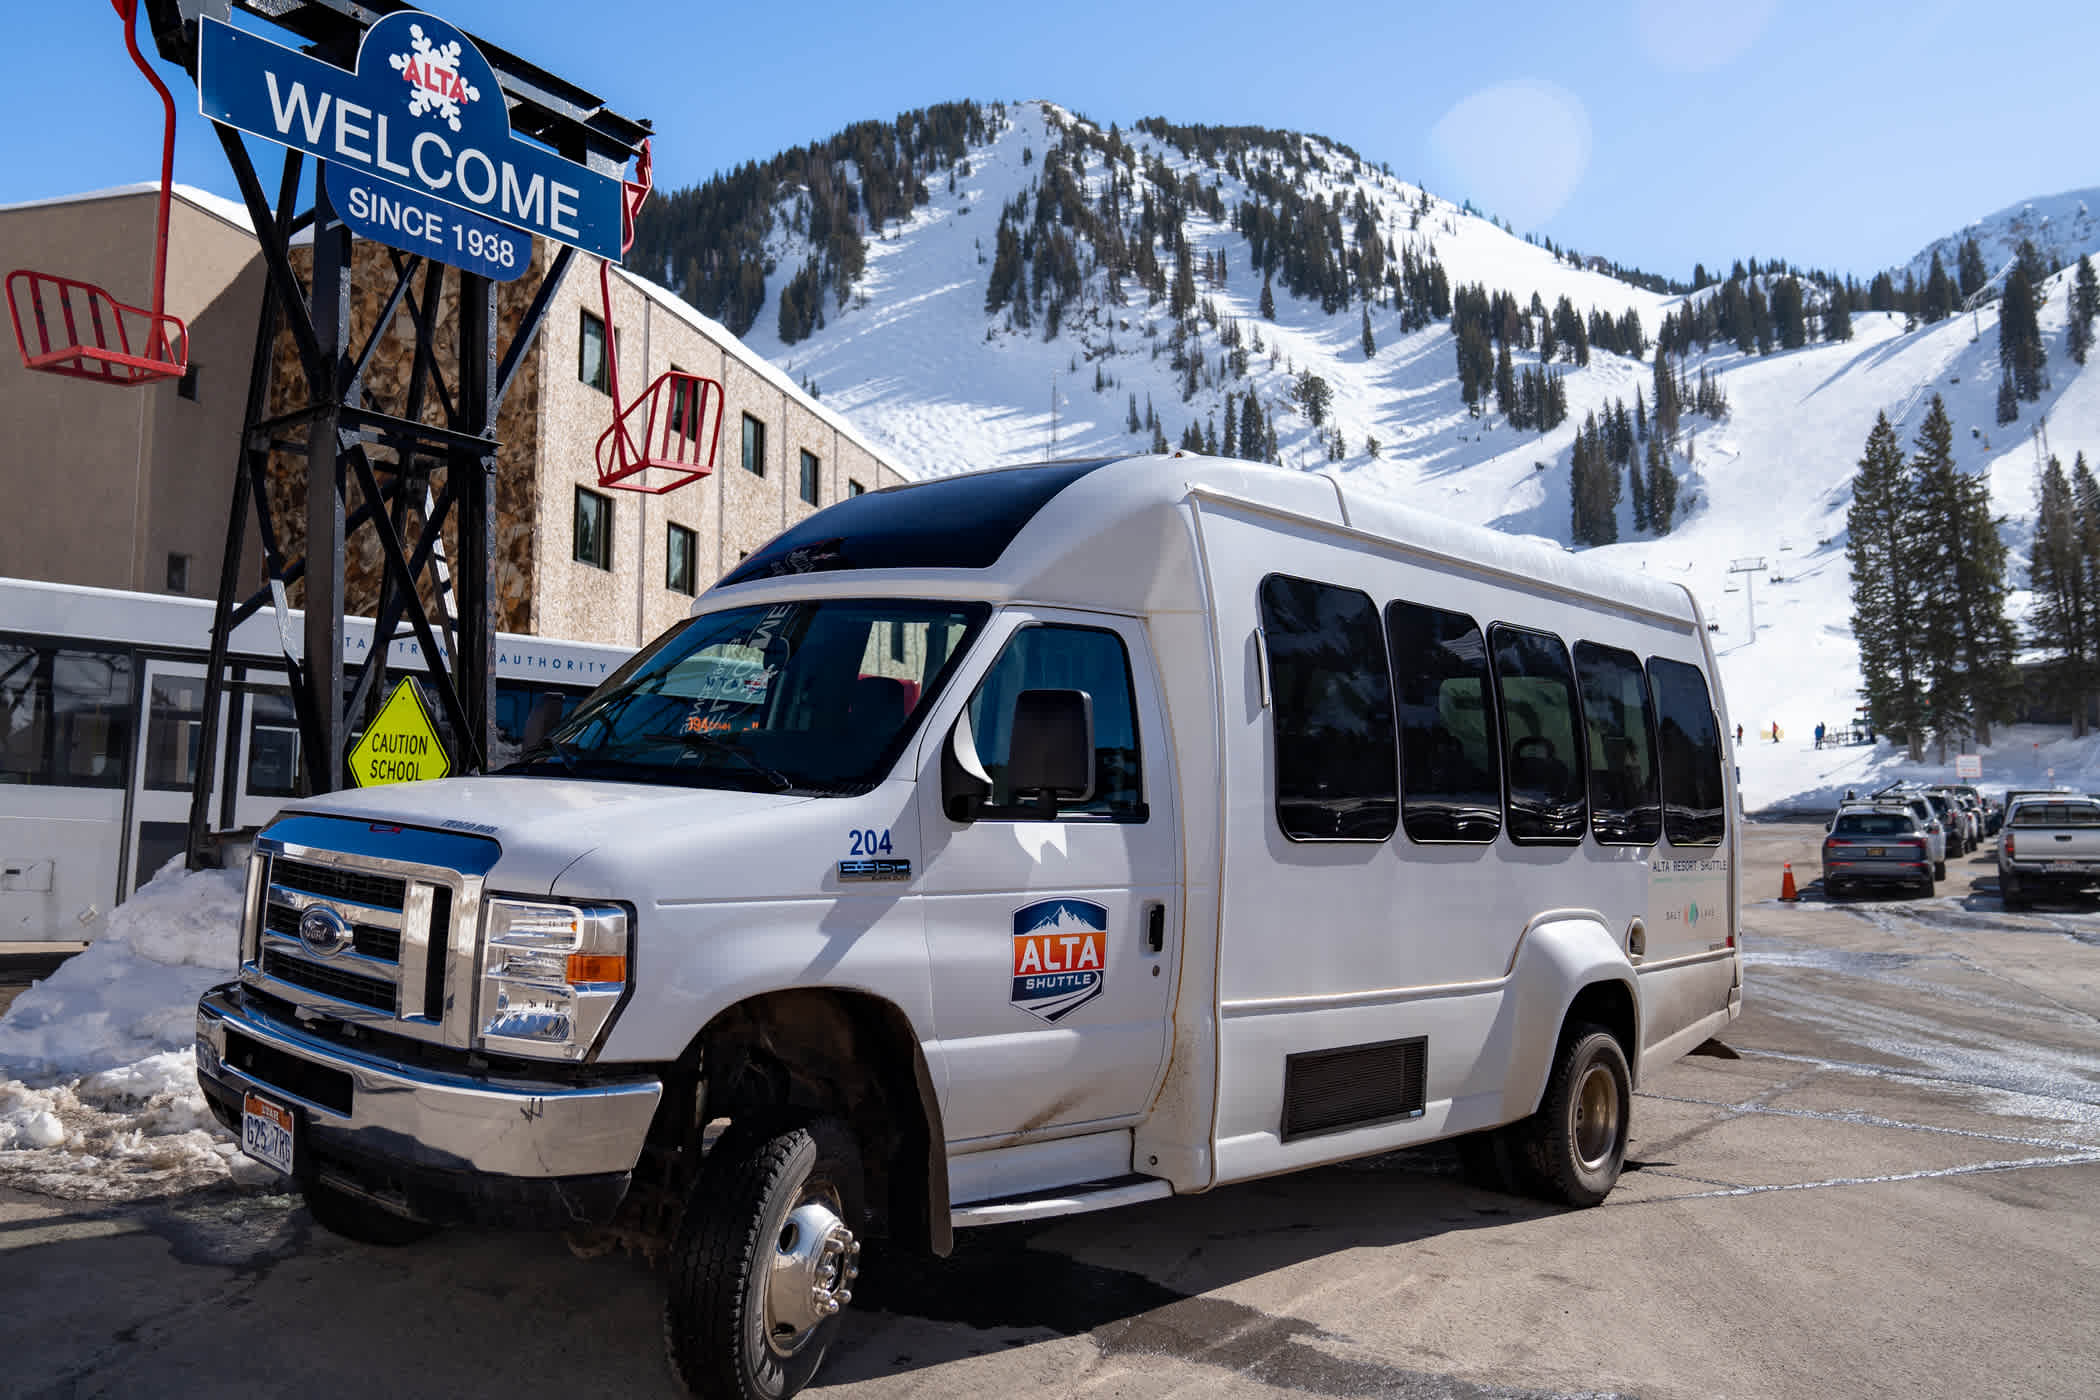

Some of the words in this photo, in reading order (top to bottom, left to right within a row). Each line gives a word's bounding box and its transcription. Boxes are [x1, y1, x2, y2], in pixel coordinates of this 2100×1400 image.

[403, 56, 468, 104] ALTA
[265, 71, 579, 239] WELCOME
[349, 187, 443, 244] SINCE
[452, 224, 514, 268] 1938
[499, 653, 607, 673] AUTHORITY
[372, 733, 428, 755] CAUTION
[370, 759, 423, 781] SCHOOL
[849, 829, 893, 855] 204
[1653, 861, 1670, 872] ALTA
[1019, 936, 1100, 973] ALTA
[1025, 974, 1092, 990] SHUTTLE
